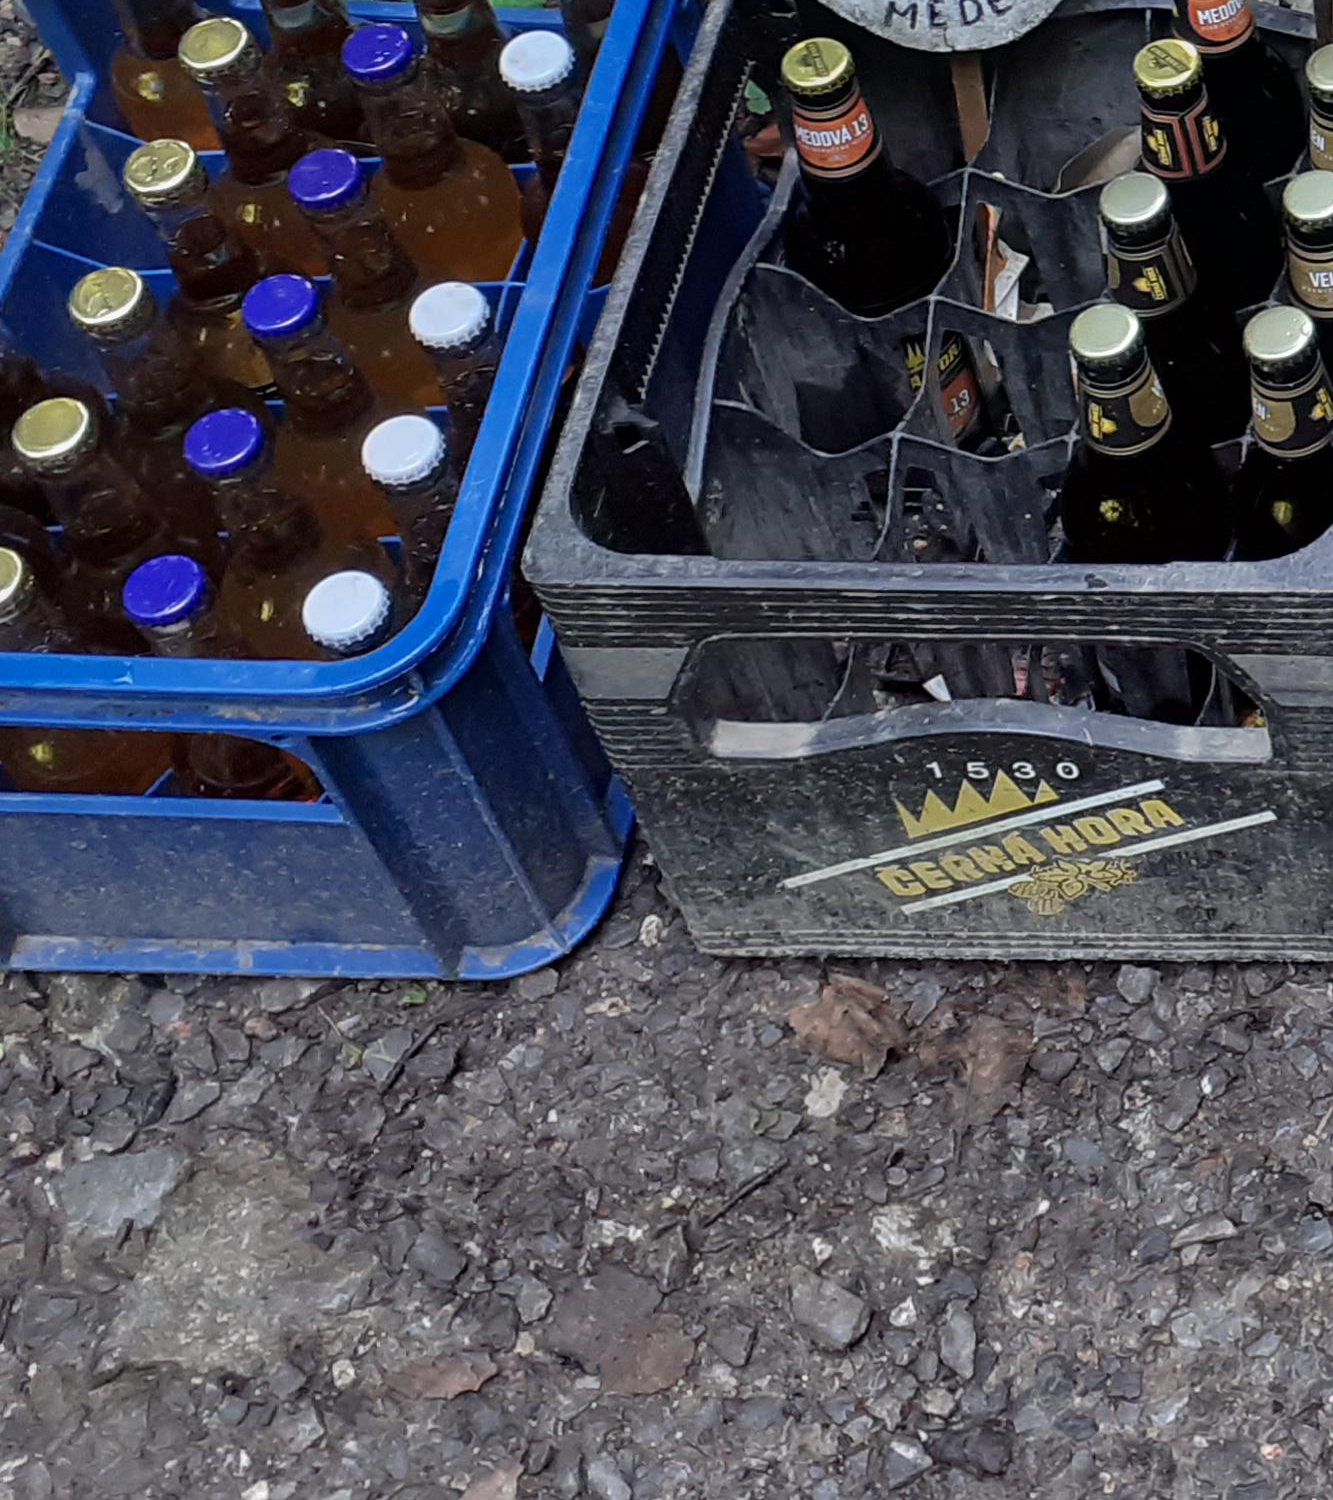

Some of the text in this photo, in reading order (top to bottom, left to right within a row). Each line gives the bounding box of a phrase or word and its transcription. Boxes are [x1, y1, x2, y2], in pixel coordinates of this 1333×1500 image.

[925, 761, 1080, 780] 1530
[873, 799, 1186, 897] ČERNÁ HORA
